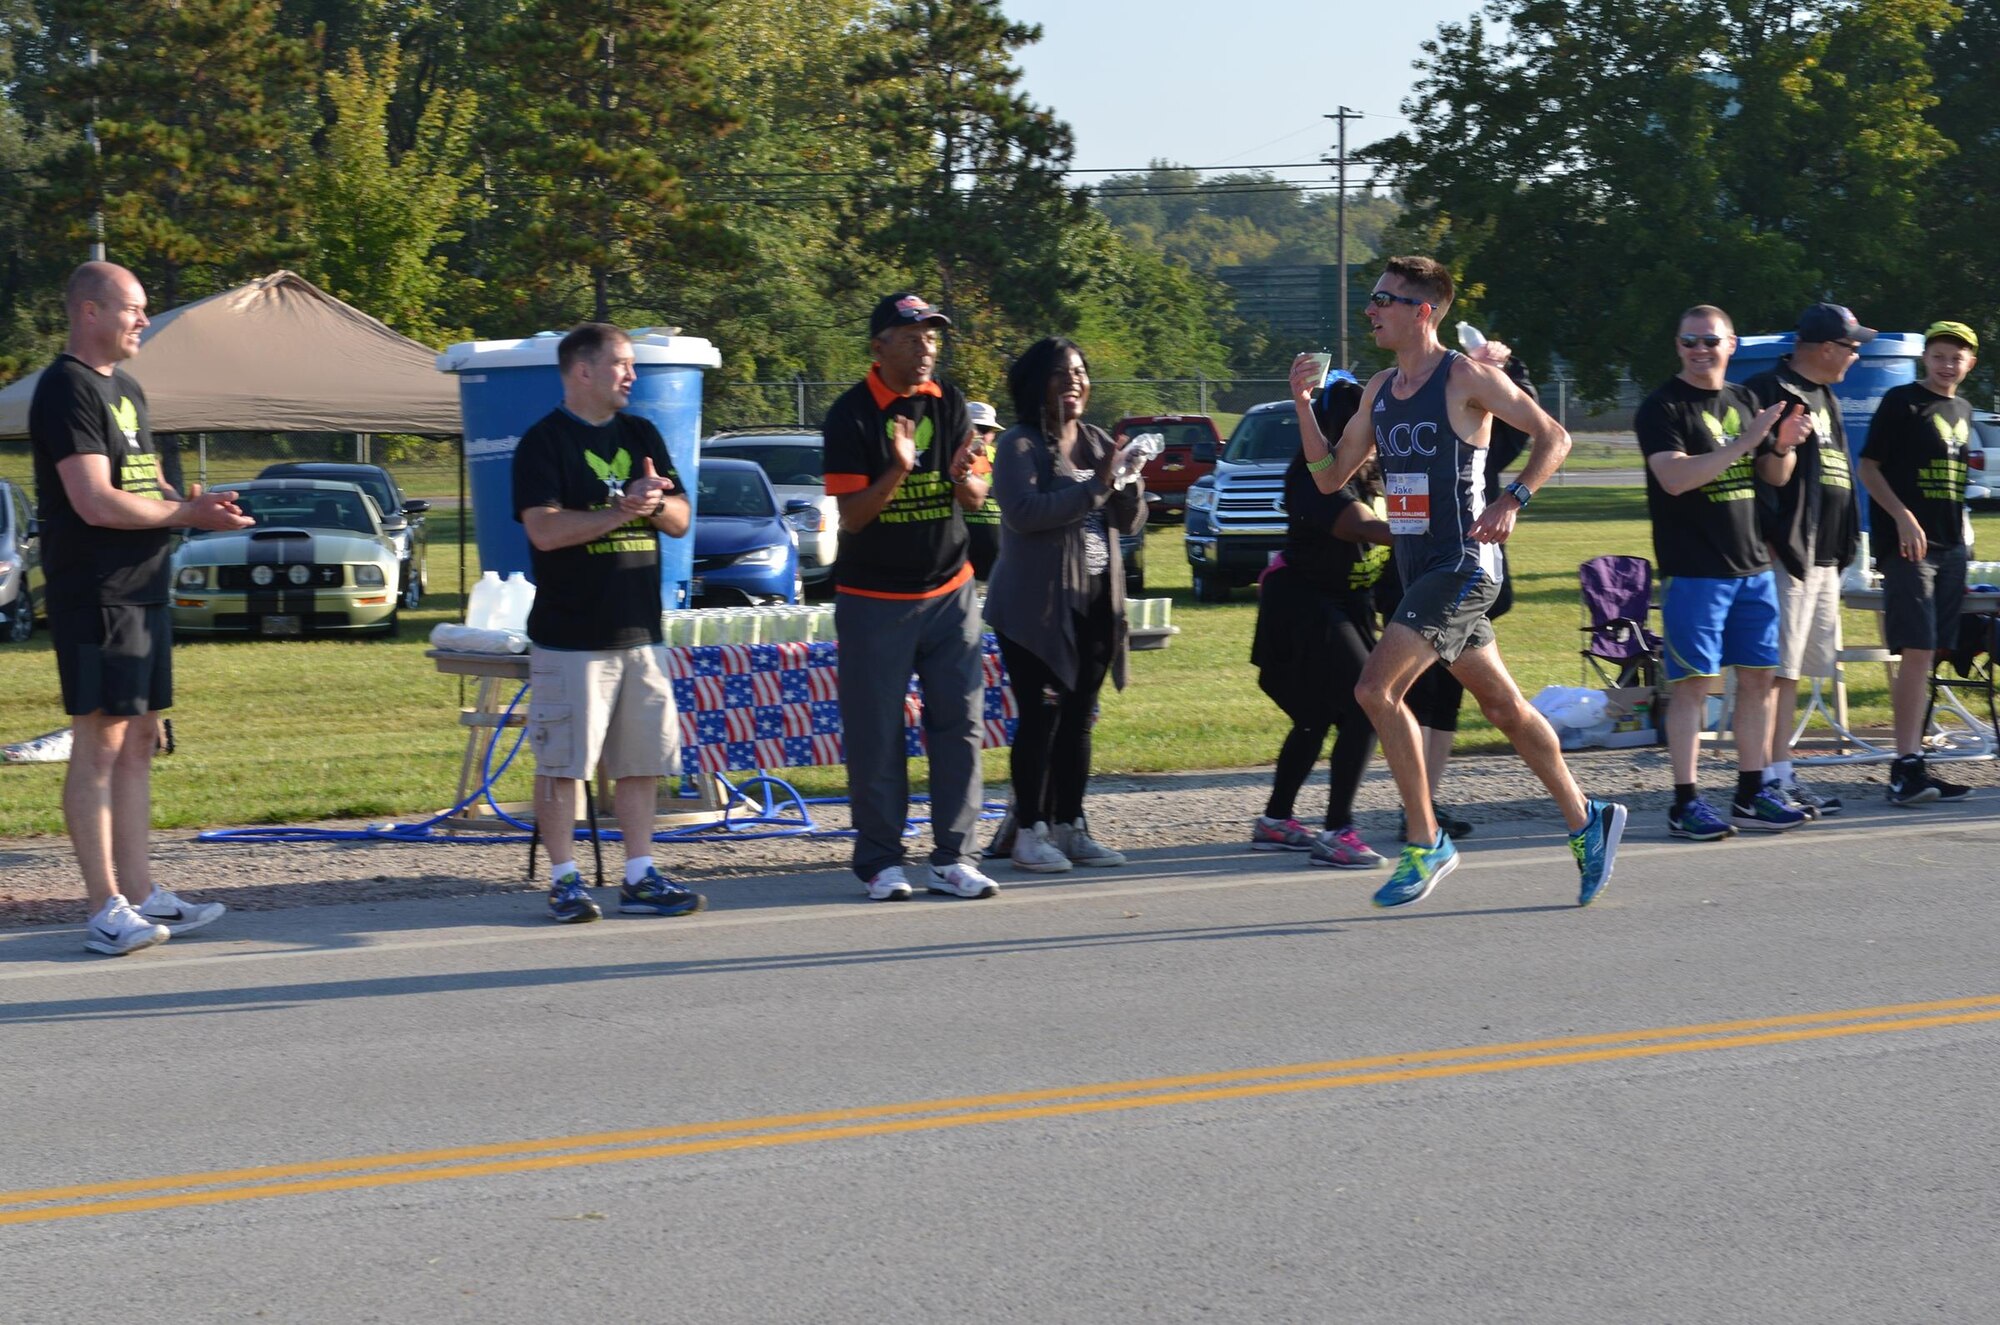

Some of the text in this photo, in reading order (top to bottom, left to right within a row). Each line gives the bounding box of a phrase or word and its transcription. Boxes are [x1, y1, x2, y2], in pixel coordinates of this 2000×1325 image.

[1376, 422, 1438, 457] ACC
[1393, 486, 1413, 495] Jake
[1399, 496, 1407, 511] 1
